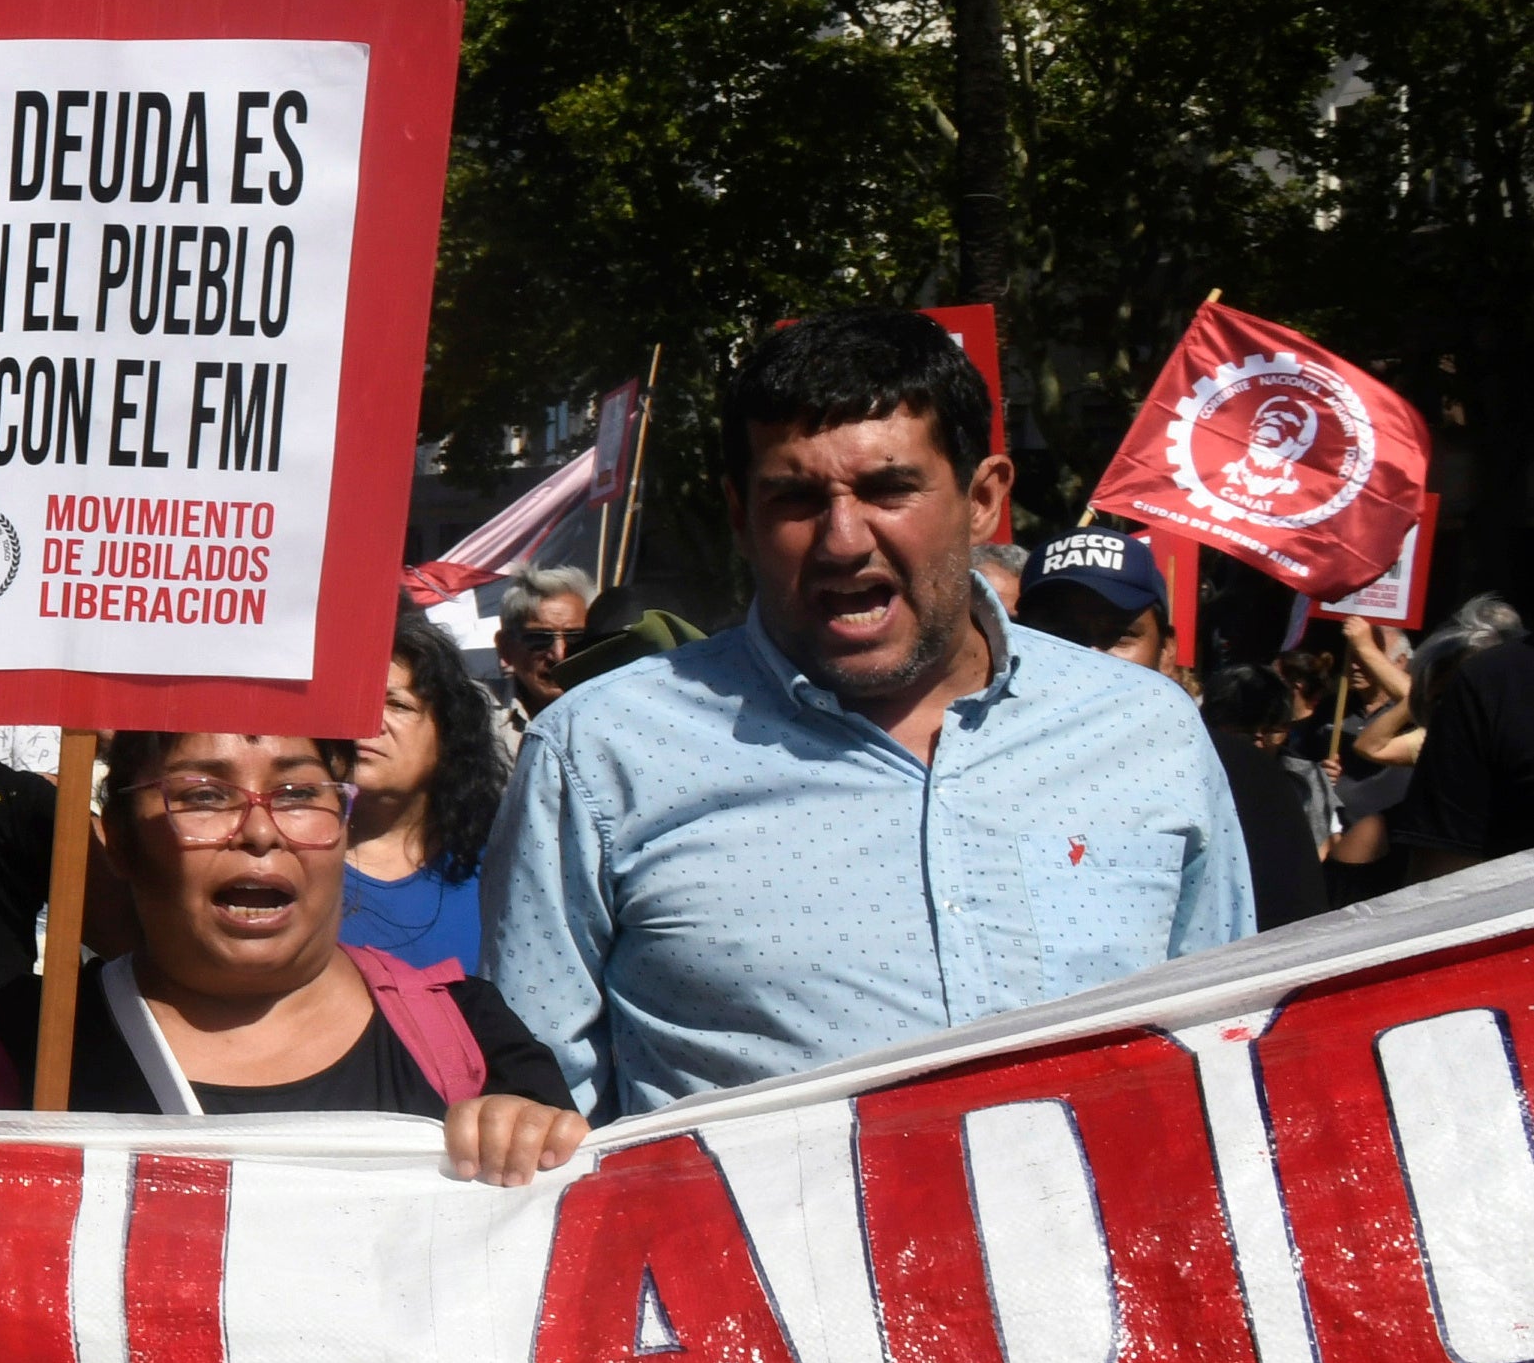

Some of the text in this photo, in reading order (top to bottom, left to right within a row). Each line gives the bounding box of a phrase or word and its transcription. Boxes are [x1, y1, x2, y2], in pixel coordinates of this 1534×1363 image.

[9, 90, 209, 204] DEUDA
[230, 89, 308, 206] ES
[22, 222, 79, 332] EL
[95, 223, 295, 339] PUEBLO
[1259, 375, 1322, 393] NACIONAL
[108, 358, 169, 469] EL
[186, 361, 288, 473] FMI
[45, 494, 275, 540] MOVIMIENTO
[1219, 486, 1274, 512] CoNAT
[42, 537, 270, 583] DE JUBILADOS
[1042, 548, 1124, 575] RANI
[1045, 534, 1125, 556] IVECO
[1132, 500, 1310, 577] CIUDAD DE BUENOS AIRES
[38, 581, 267, 625] LIBERACION
